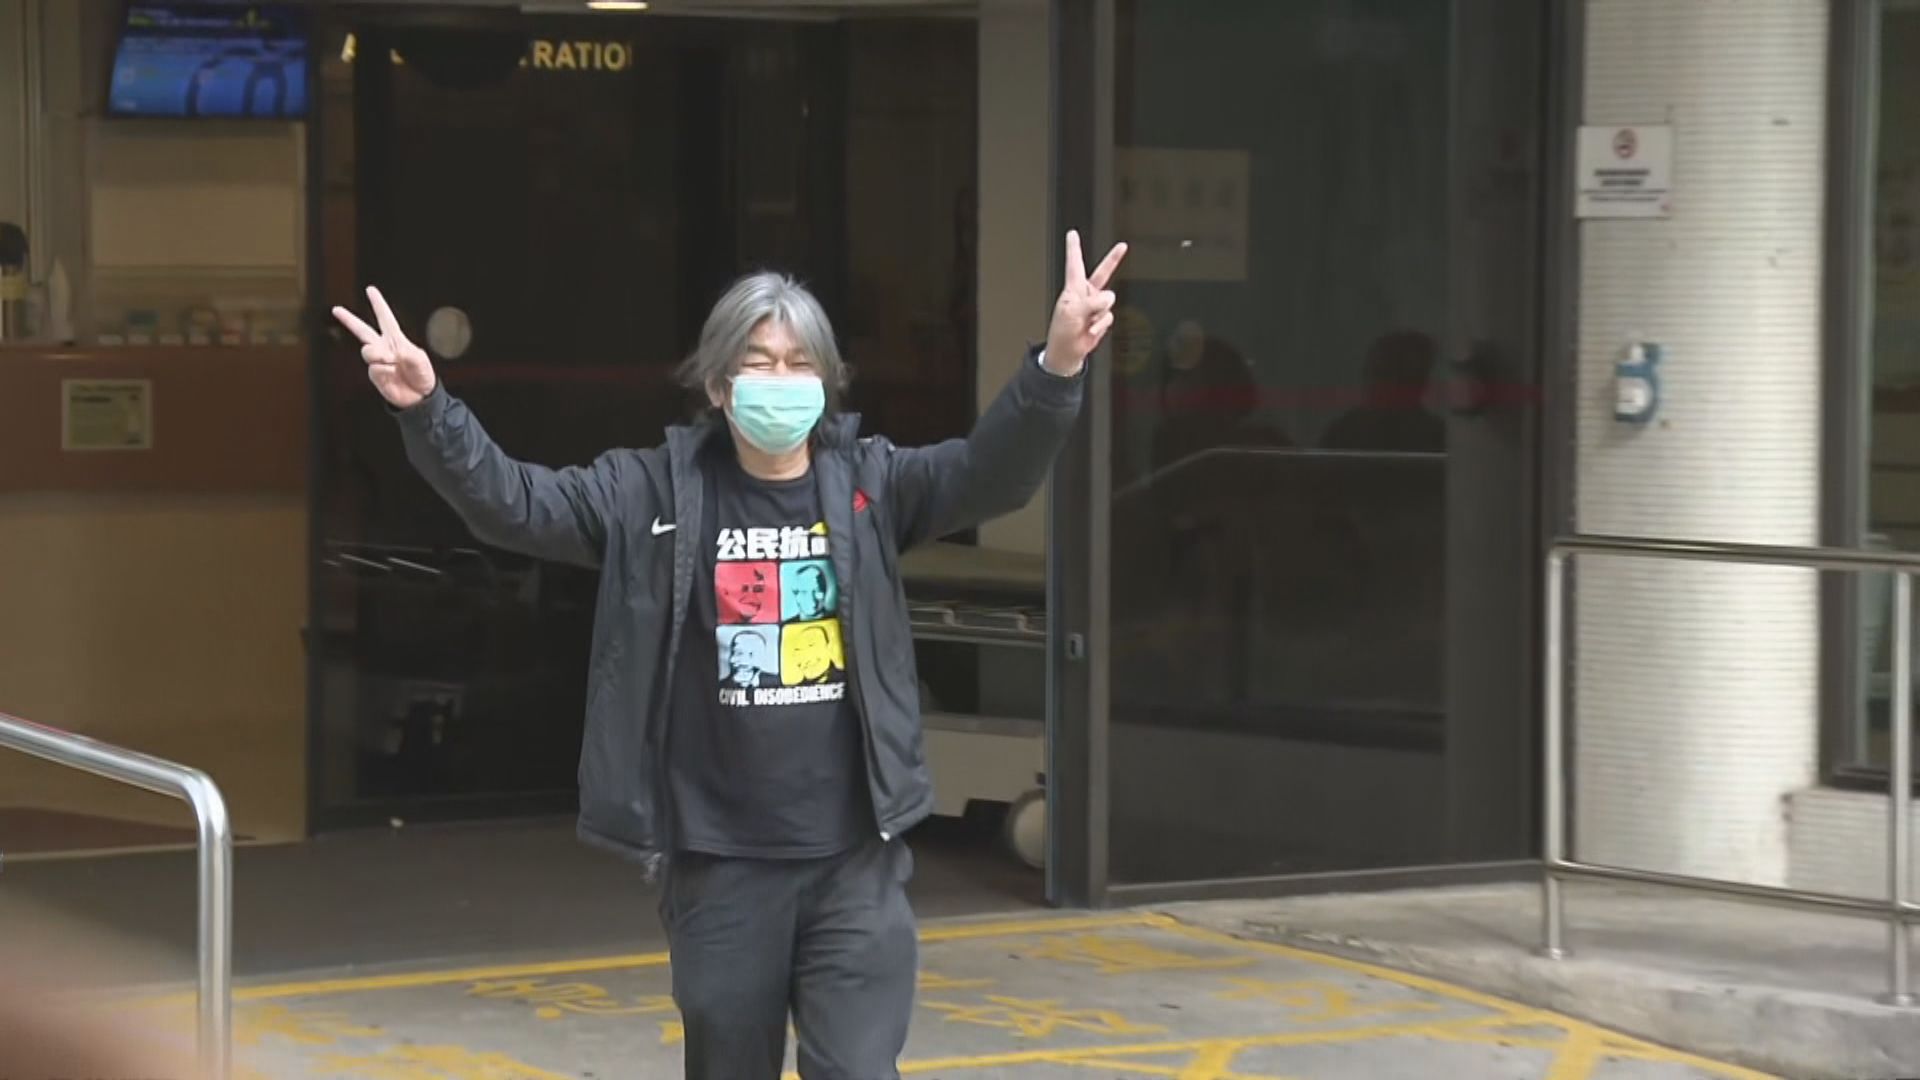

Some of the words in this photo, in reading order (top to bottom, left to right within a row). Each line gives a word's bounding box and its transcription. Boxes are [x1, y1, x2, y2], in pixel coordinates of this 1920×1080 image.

[519, 38, 632, 72] RATIO
[718, 687, 750, 707] CIVIL
[753, 682, 846, 706] DISOBEDIENCE
